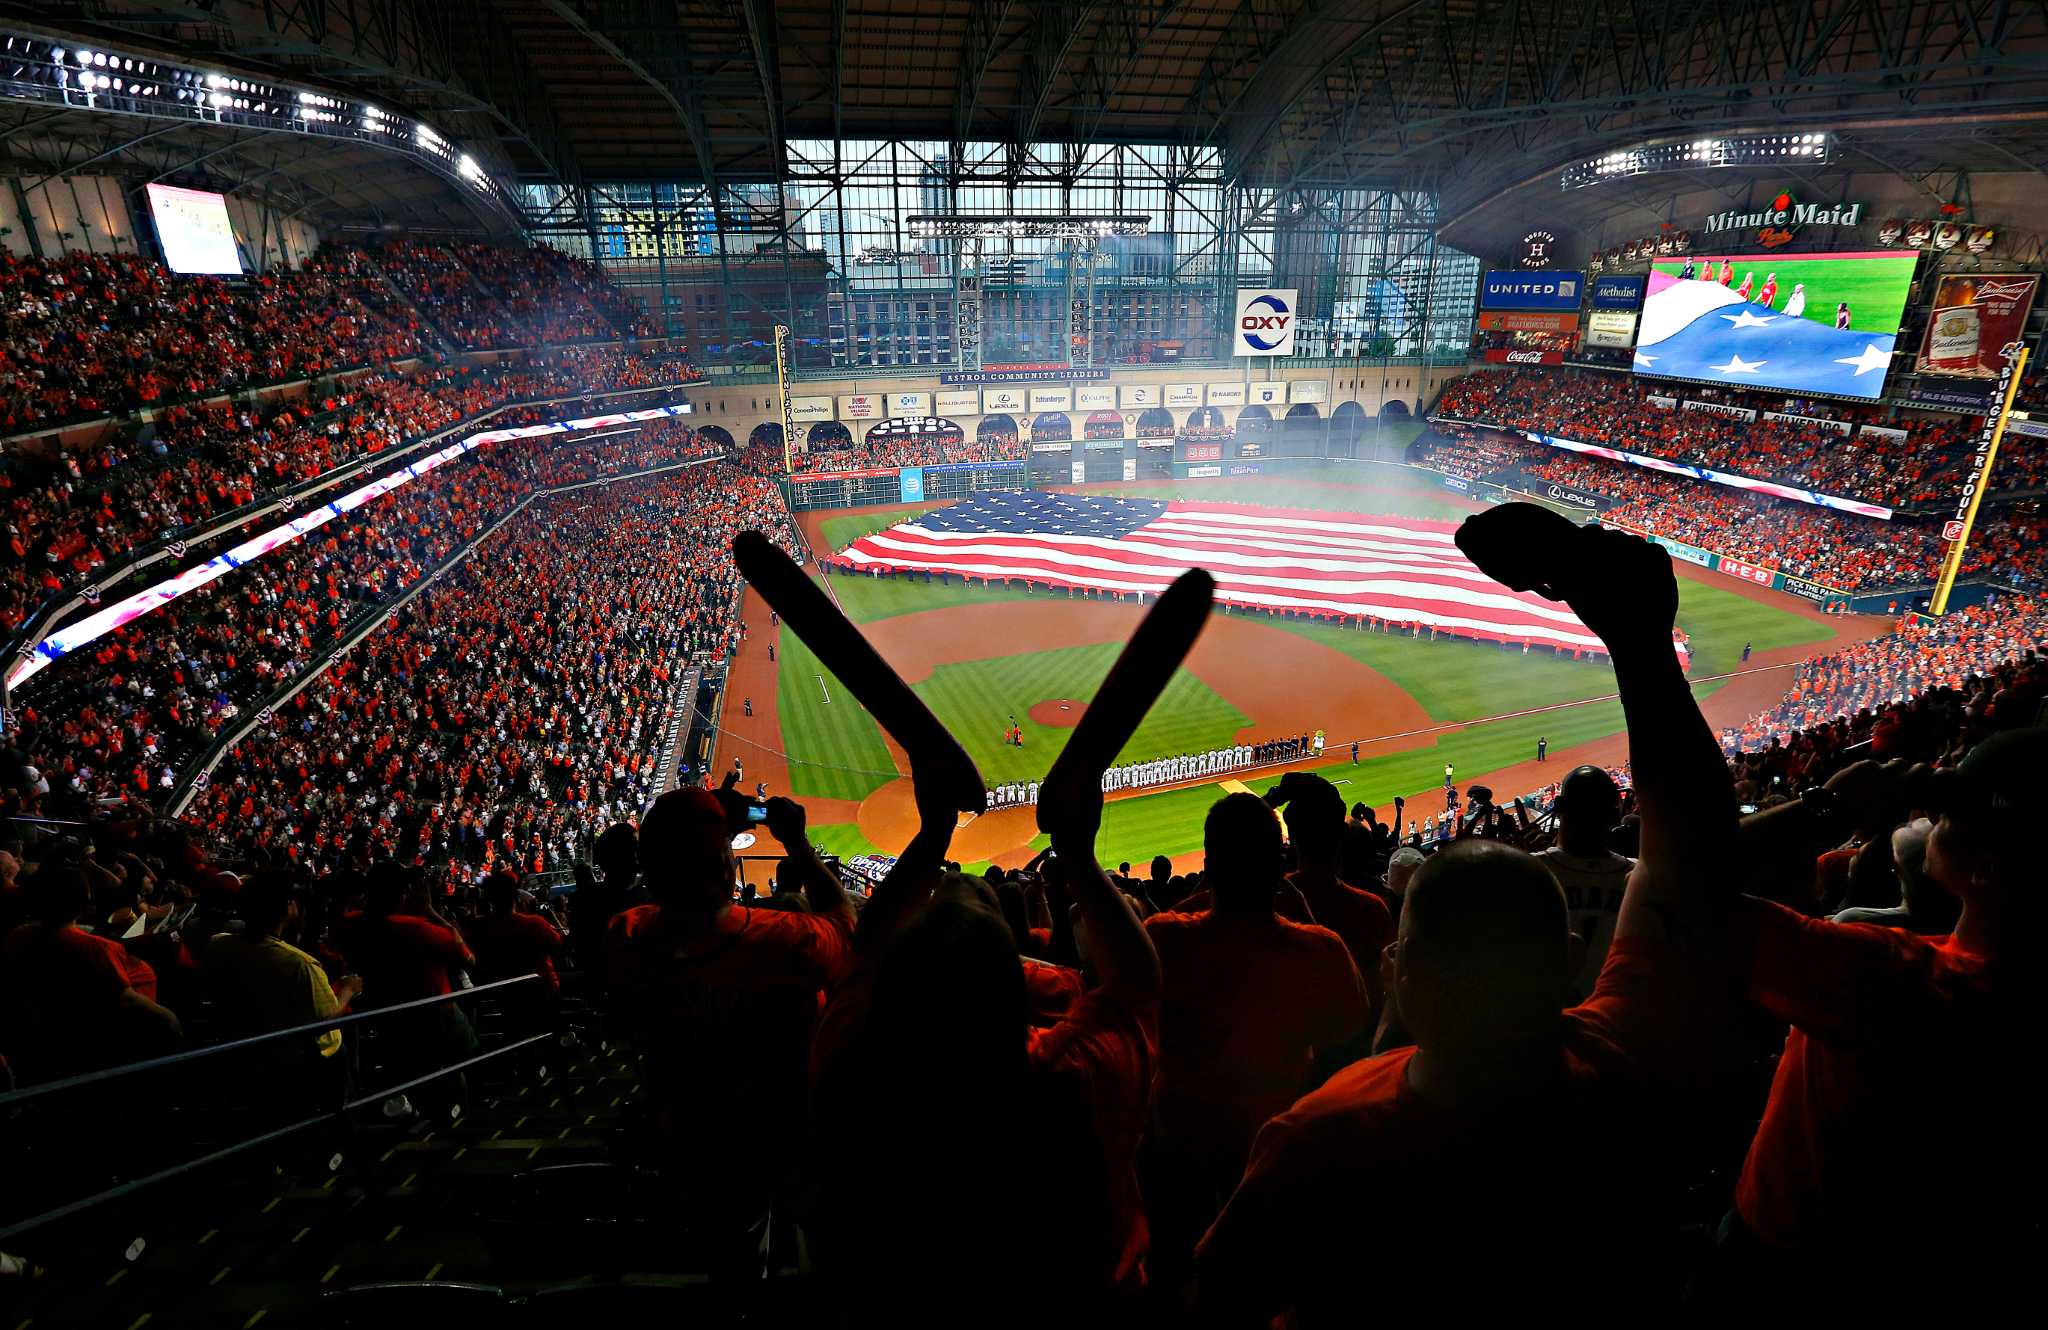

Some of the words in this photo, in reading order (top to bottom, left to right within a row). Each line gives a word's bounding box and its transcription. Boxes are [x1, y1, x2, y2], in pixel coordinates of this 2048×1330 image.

[1704, 207, 1787, 233] Minute
[1790, 203, 1860, 226] Maid
[1489, 284, 1555, 294] UNITED
[1241, 316, 1290, 330] OXY
[947, 374, 986, 382] ASTROS
[990, 372, 1056, 380] COMMUNITY
[1060, 371, 1104, 379] LEADERS
[1688, 403, 1749, 421] CHEVROLET
[1976, 367, 2011, 452] BURGERZ
[1445, 477, 1467, 490] GEICO
[1562, 491, 1596, 507] LEXUS
[1956, 472, 1980, 520] FOUL
[1787, 579, 1804, 589] PICK
[1805, 584, 1819, 594] THE
[665, 719, 681, 747] MINUTE
